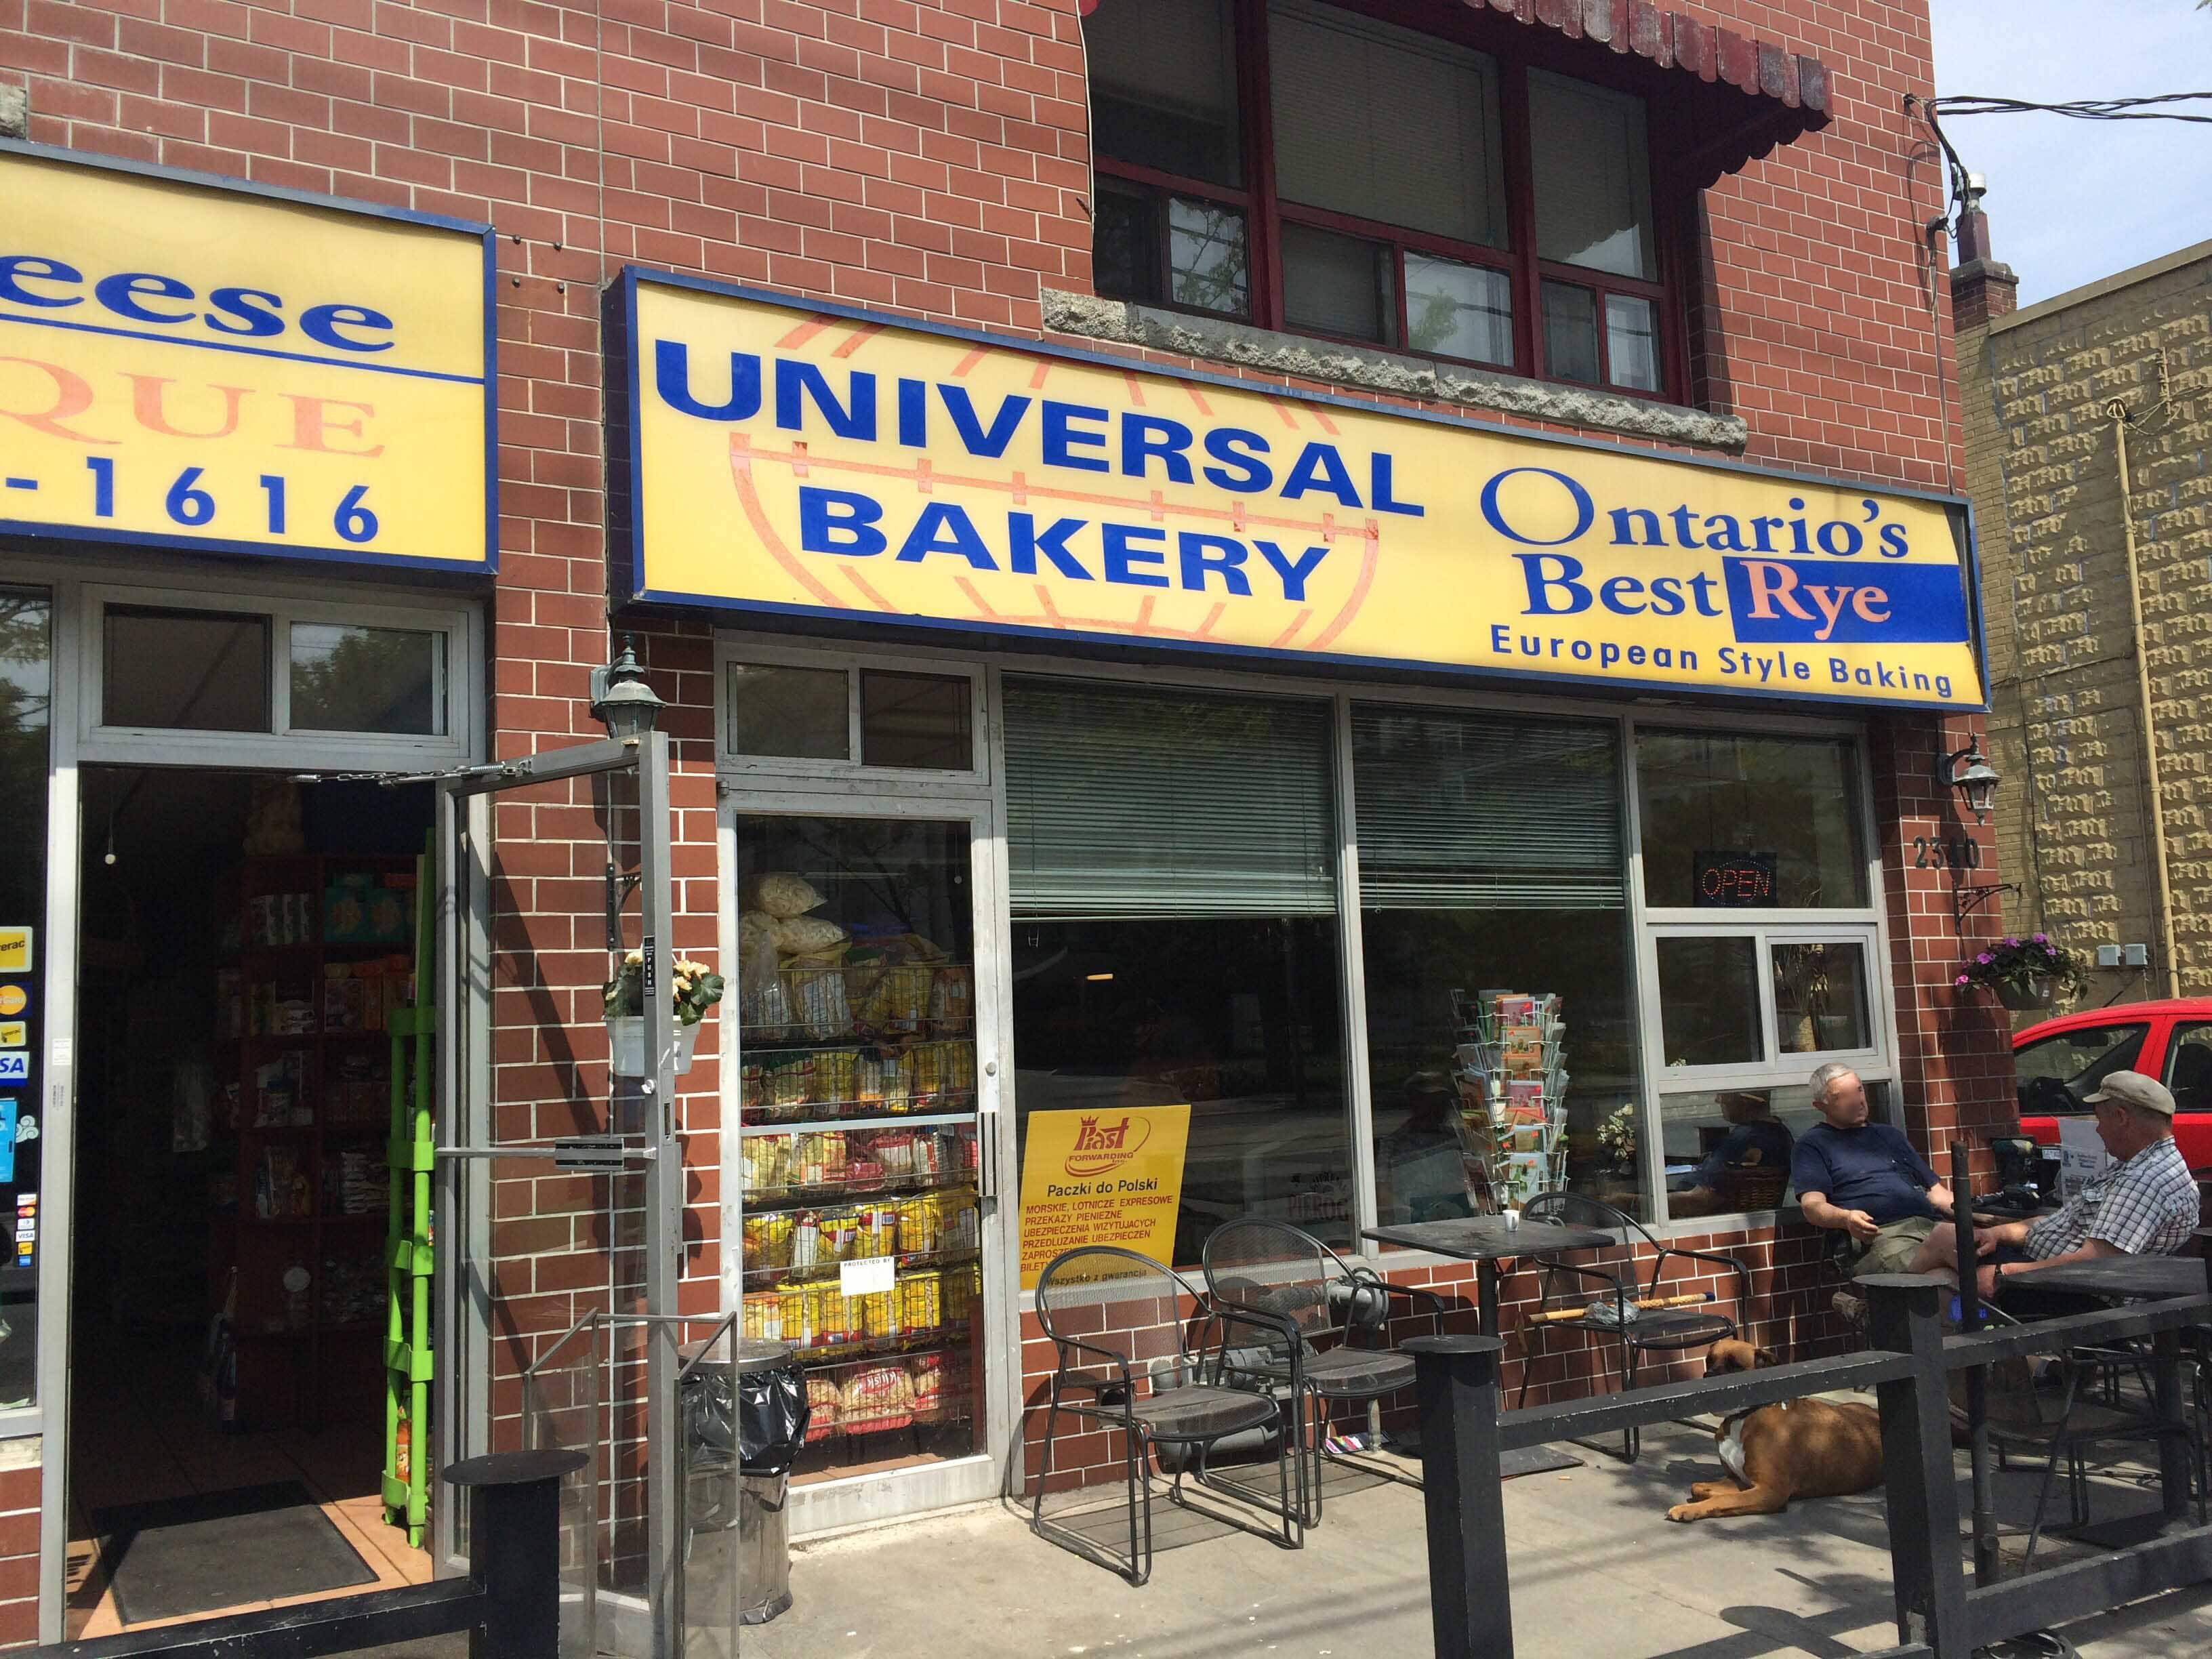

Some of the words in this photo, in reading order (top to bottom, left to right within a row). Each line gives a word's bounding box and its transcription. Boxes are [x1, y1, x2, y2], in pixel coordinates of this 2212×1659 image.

[655, 339, 1424, 517] UNIVERSAL
[1480, 467, 1908, 558] Ontario's
[799, 486, 1330, 602] BAKERY
[1512, 554, 1723, 616] Best
[1740, 560, 1891, 640] Rye
[1491, 625, 1698, 670] European
[1718, 647, 1810, 682] Style
[1831, 657, 1952, 698] Baking
[1702, 867, 1771, 897] OPEN
[1073, 1117, 1130, 1151] Piast
[1069, 1152, 1134, 1162] FORWARDING
[1047, 1182, 1092, 1197] Paczki
[1096, 1182, 1113, 1193] do
[1118, 1178, 1158, 1192] Polski
[1072, 1199, 1115, 1210] LOTNICZE
[1120, 1195, 1173, 1207] EXPRESOWE
[1025, 1214, 1073, 1225] PRZEKAZY
[1076, 1210, 1122, 1222] PIENIEZNE
[1024, 1225, 1090, 1237] UBEZPIECZENIA
[1093, 1218, 1156, 1231] WIZYTUJACYCH
[1023, 1236, 1088, 1249] PRZEDLUZANIE
[1092, 1230, 1151, 1243] UBEZPIECZEN
[844, 1259, 880, 1267] PROTECTED
[1022, 1248, 1071, 1261] ZAPROSZ
